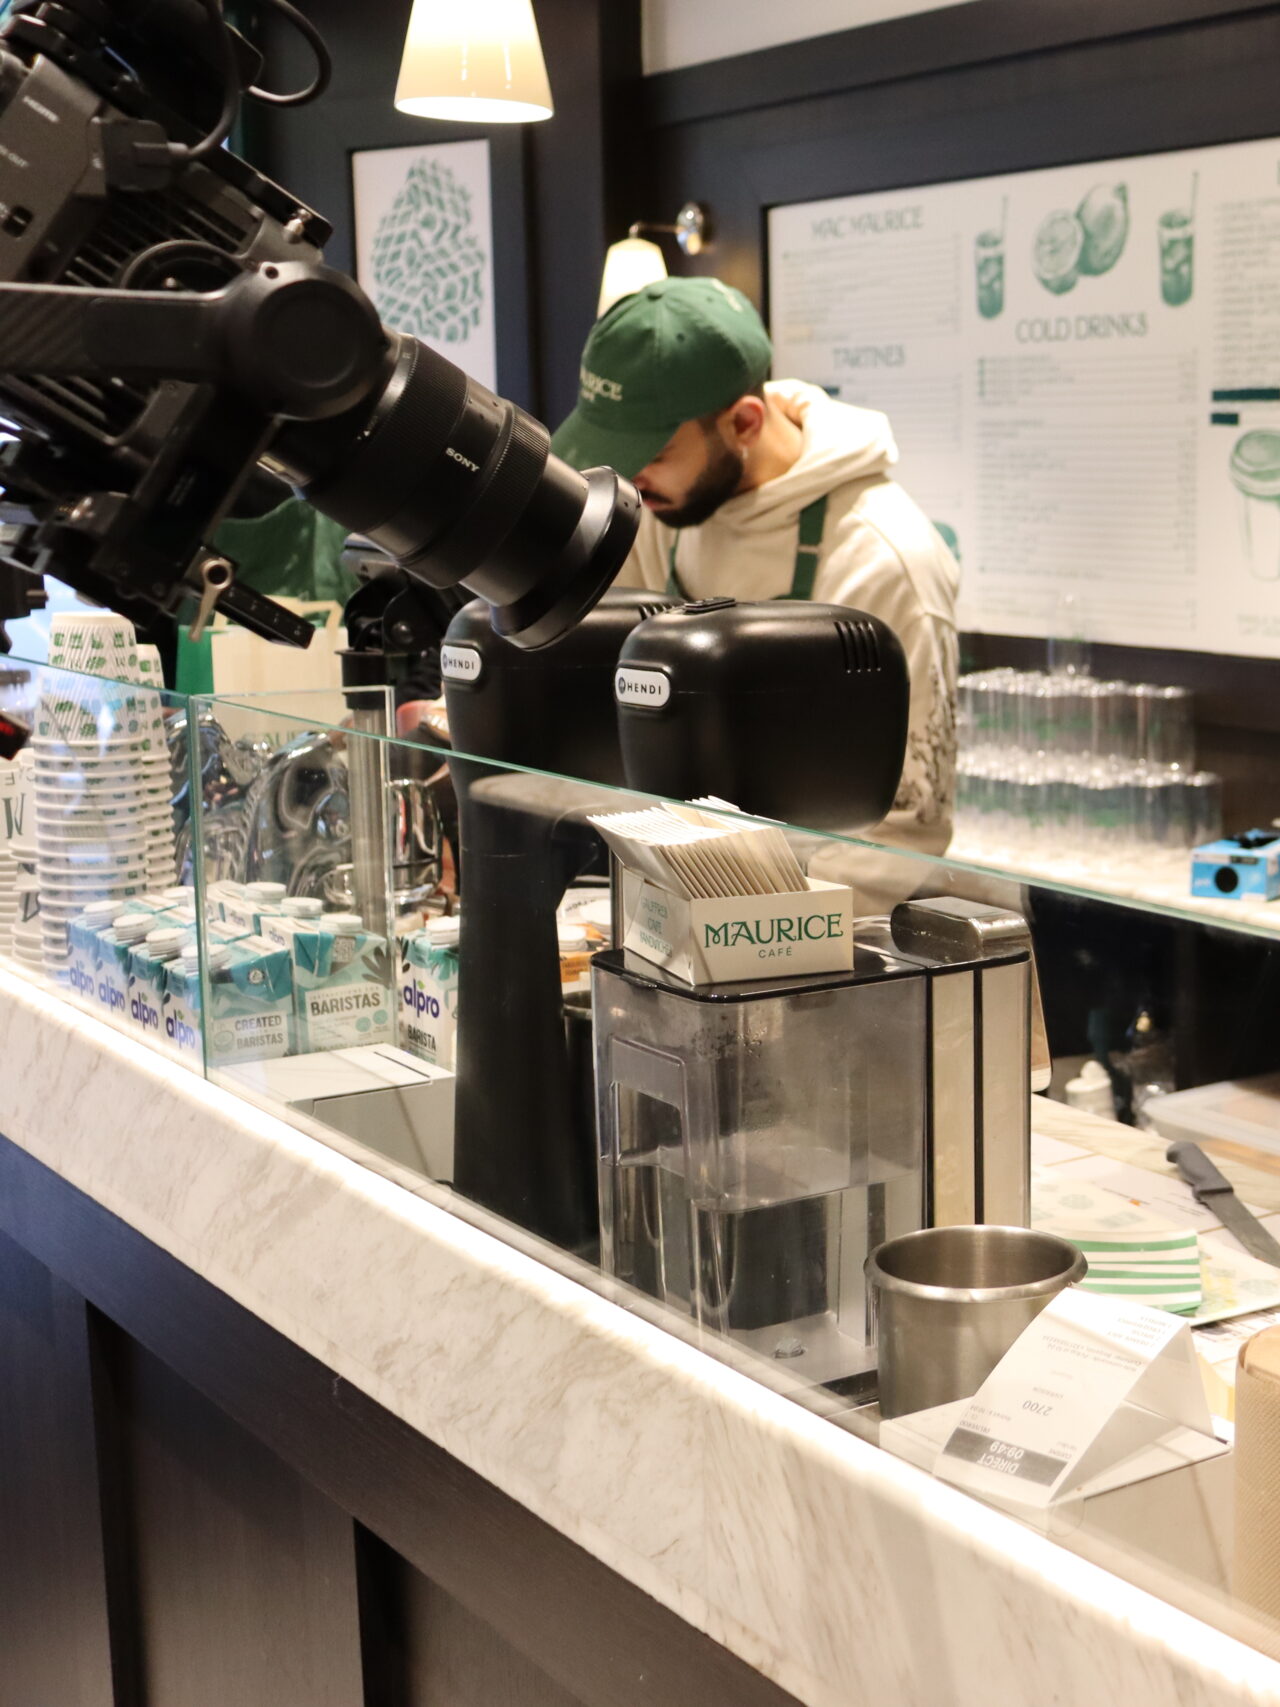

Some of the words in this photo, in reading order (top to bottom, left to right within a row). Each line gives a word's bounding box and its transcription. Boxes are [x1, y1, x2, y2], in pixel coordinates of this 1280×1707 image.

[1016, 317, 1072, 343] COLD
[1075, 311, 1148, 341] DRINKS
[446, 447, 480, 472] SONY
[448, 660, 475, 670] HENDI
[626, 683, 662, 695] HENDI
[704, 913, 844, 948] MAURICE
[758, 946, 793, 959] CAFÉ
[70, 960, 94, 995] alpro
[98, 976, 125, 1013] alpro
[310, 992, 381, 1017] BARISTAS
[403, 978, 440, 1018] alpro
[131, 992, 158, 1030] alpro
[234, 1015, 282, 1031] CREATED
[166, 1009, 195, 1049] alpro
[236, 1033, 284, 1050] BARISTAS
[1022, 1400, 1053, 1416] 2700
[990, 1441, 1024, 1459] 09:49
[976, 1452, 1020, 1474] DIRECT
